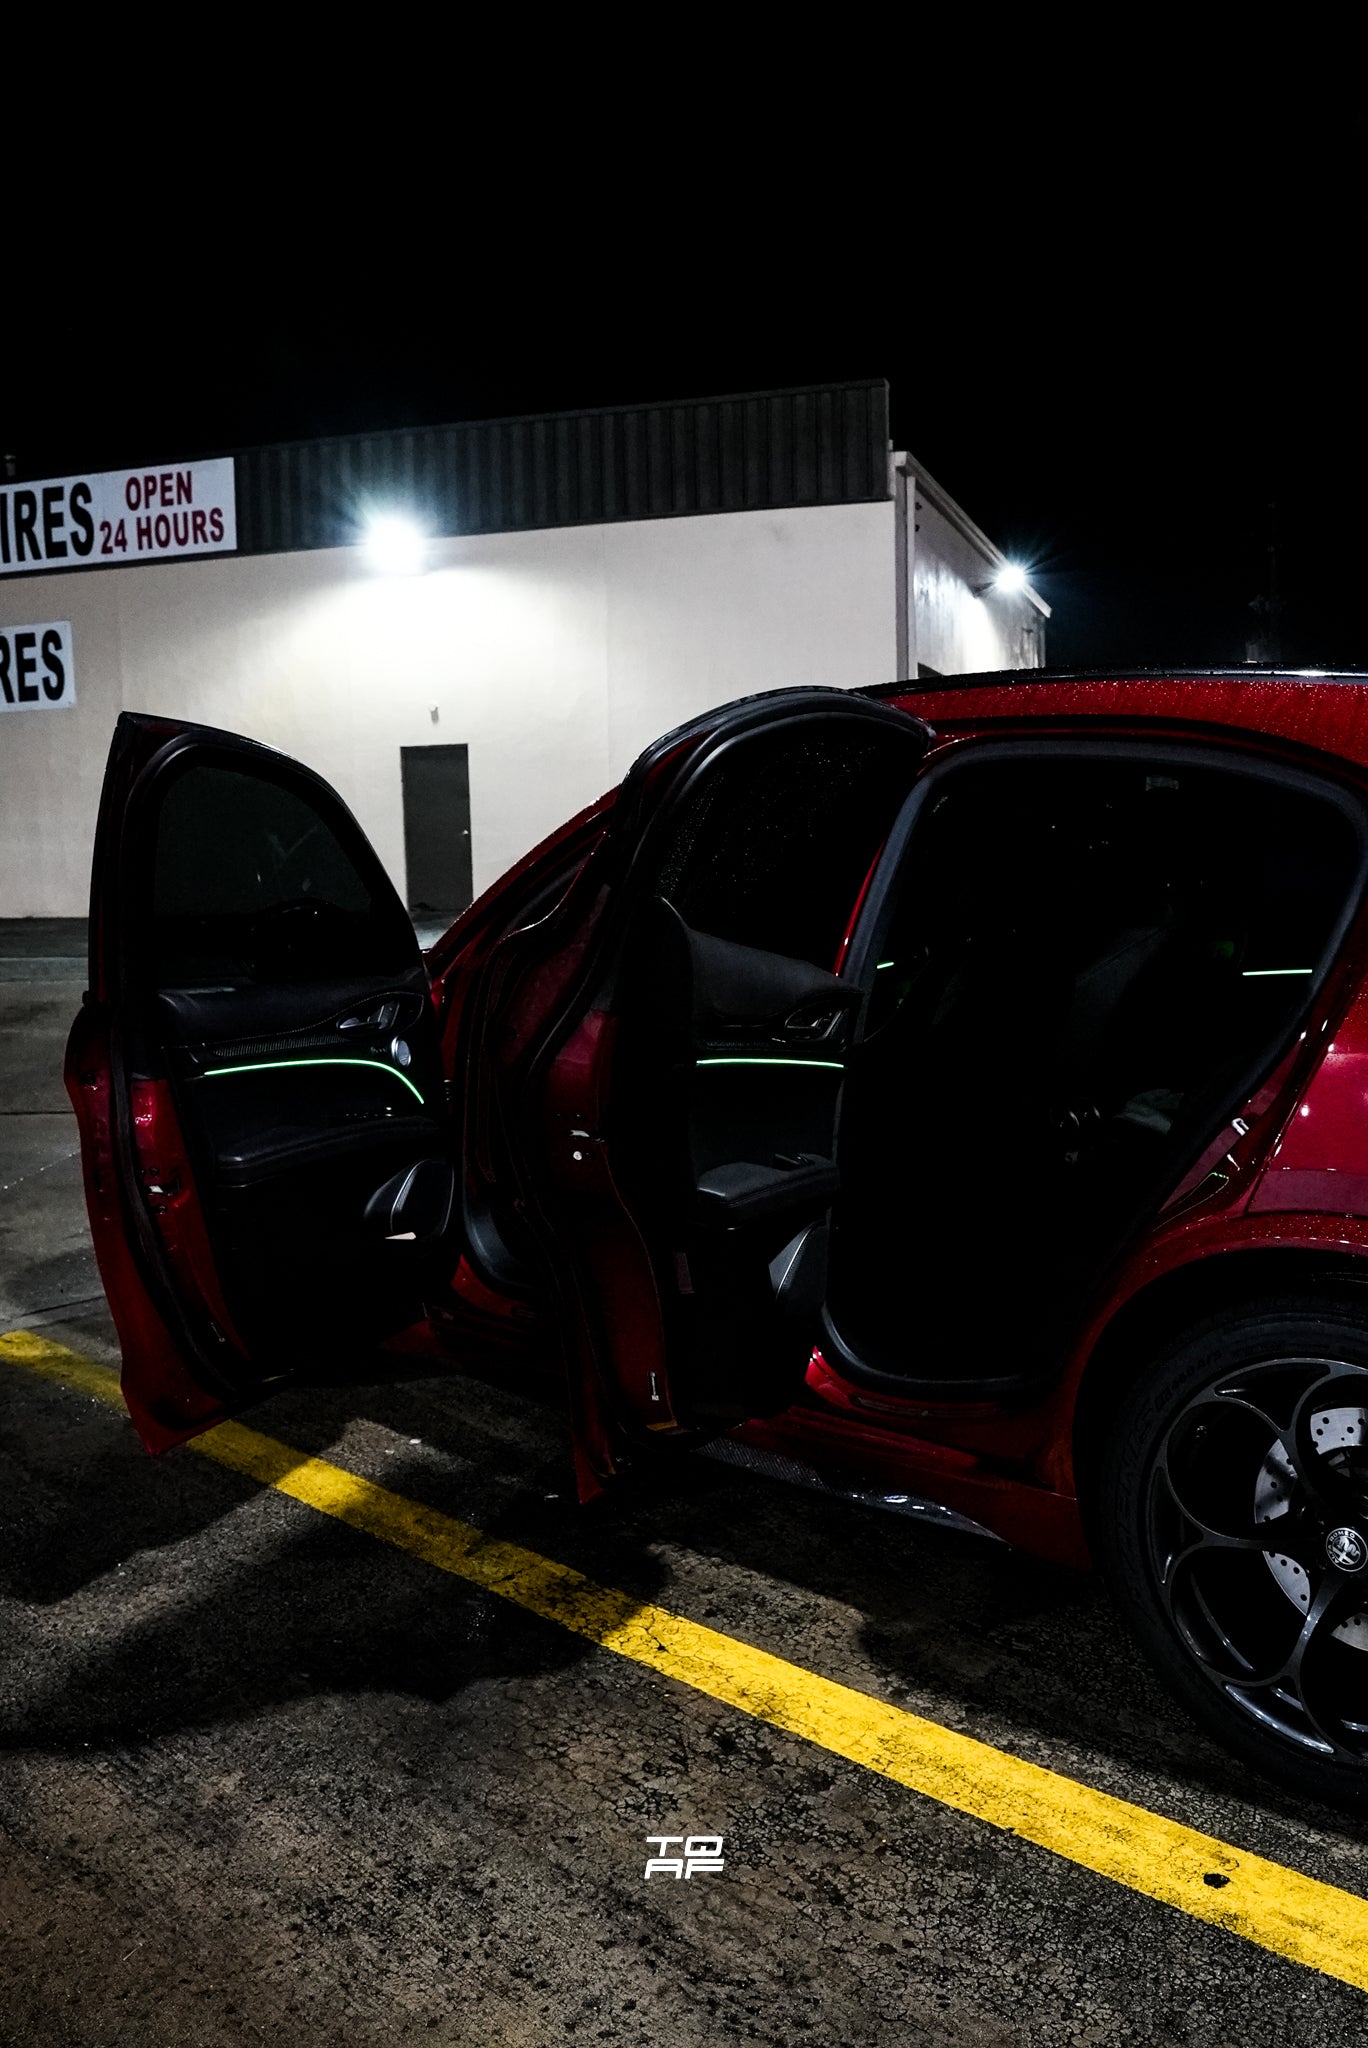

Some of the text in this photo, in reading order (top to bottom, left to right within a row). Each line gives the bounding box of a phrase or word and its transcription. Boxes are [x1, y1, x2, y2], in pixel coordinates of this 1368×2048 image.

[125, 470, 193, 511] OPEN
[99, 507, 225, 554] 24 HOURS
